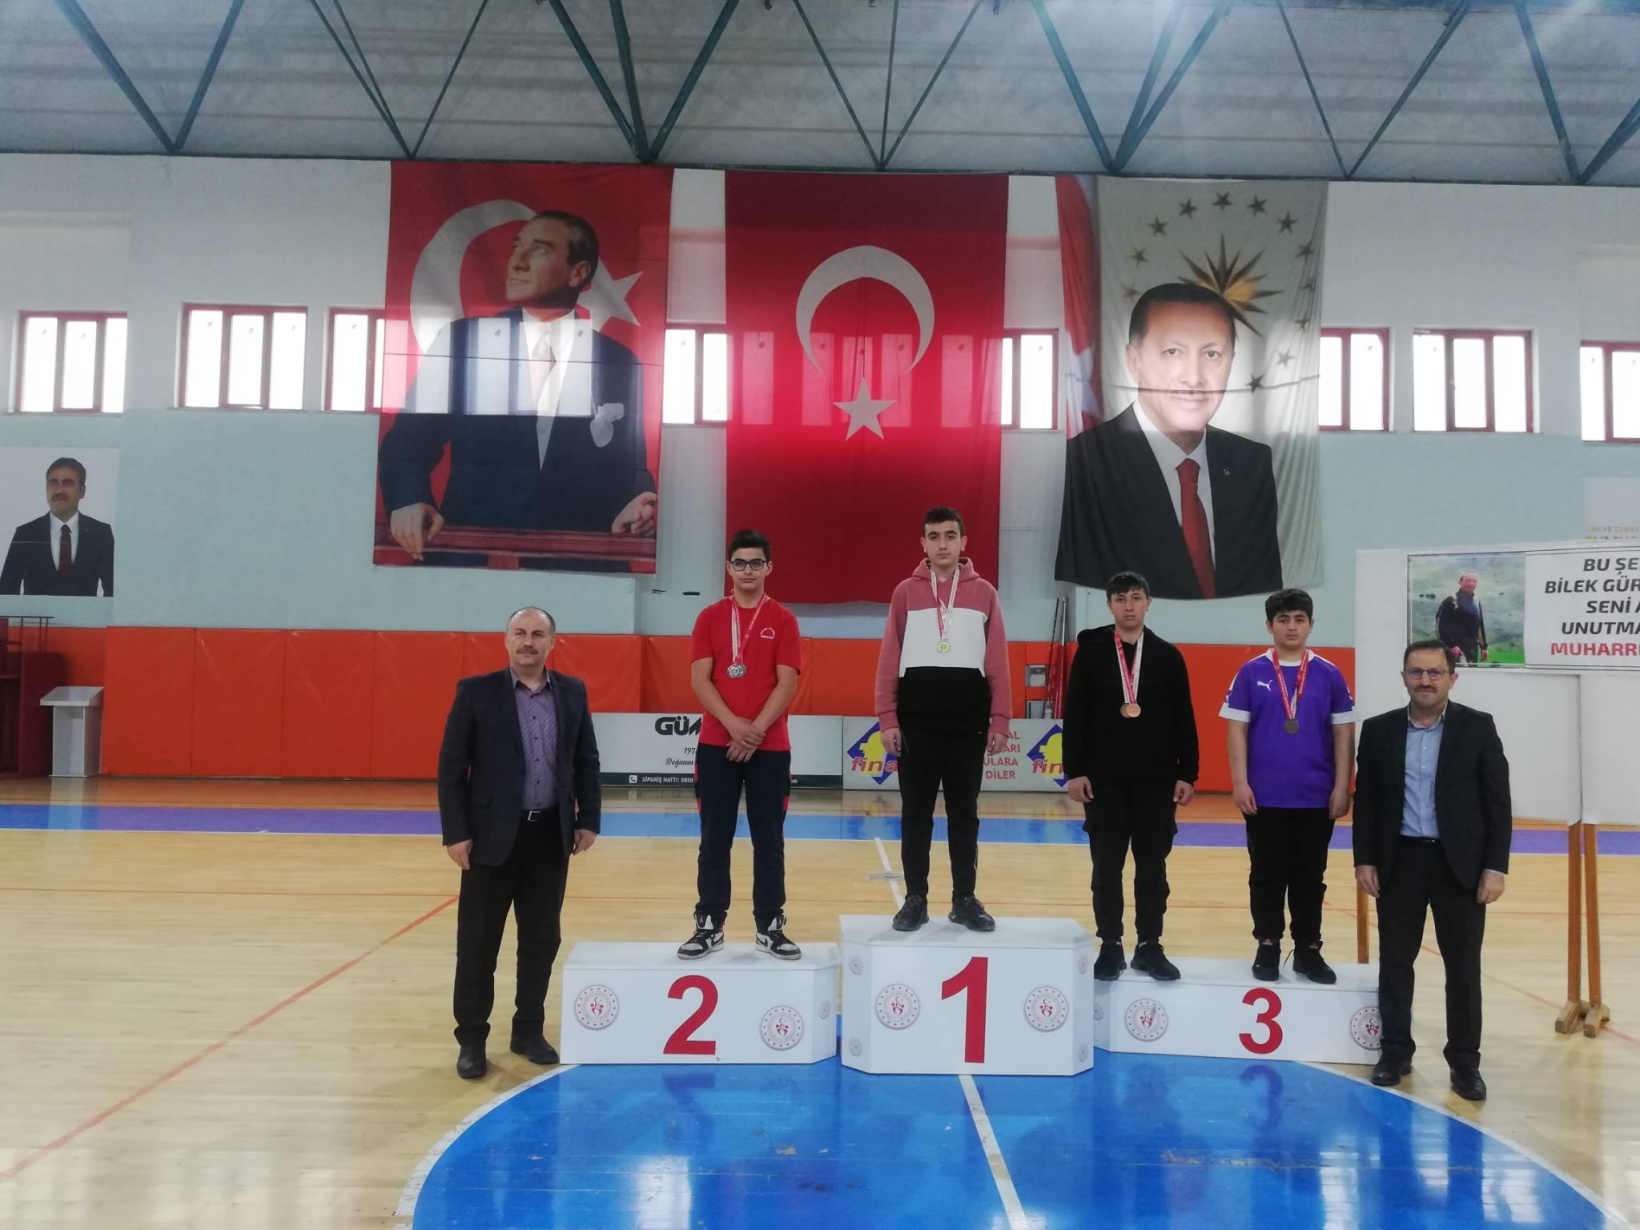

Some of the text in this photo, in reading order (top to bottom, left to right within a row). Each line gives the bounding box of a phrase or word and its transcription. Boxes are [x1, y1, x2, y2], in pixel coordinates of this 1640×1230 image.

[1583, 557, 1640, 575] BU ŞE
[1545, 577, 1599, 594] BİLEK
[1586, 597, 1631, 613] SENİ
[1551, 643, 1640, 656] MUHARR
[684, 747, 697, 755] 197
[852, 757, 898, 773] fina
[984, 757, 1018, 767] ULARA
[1032, 758, 1064, 774] fin
[986, 768, 1017, 779] DİLER
[663, 975, 719, 1055] 2
[942, 956, 988, 1063] 1
[1239, 987, 1283, 1055] 3
